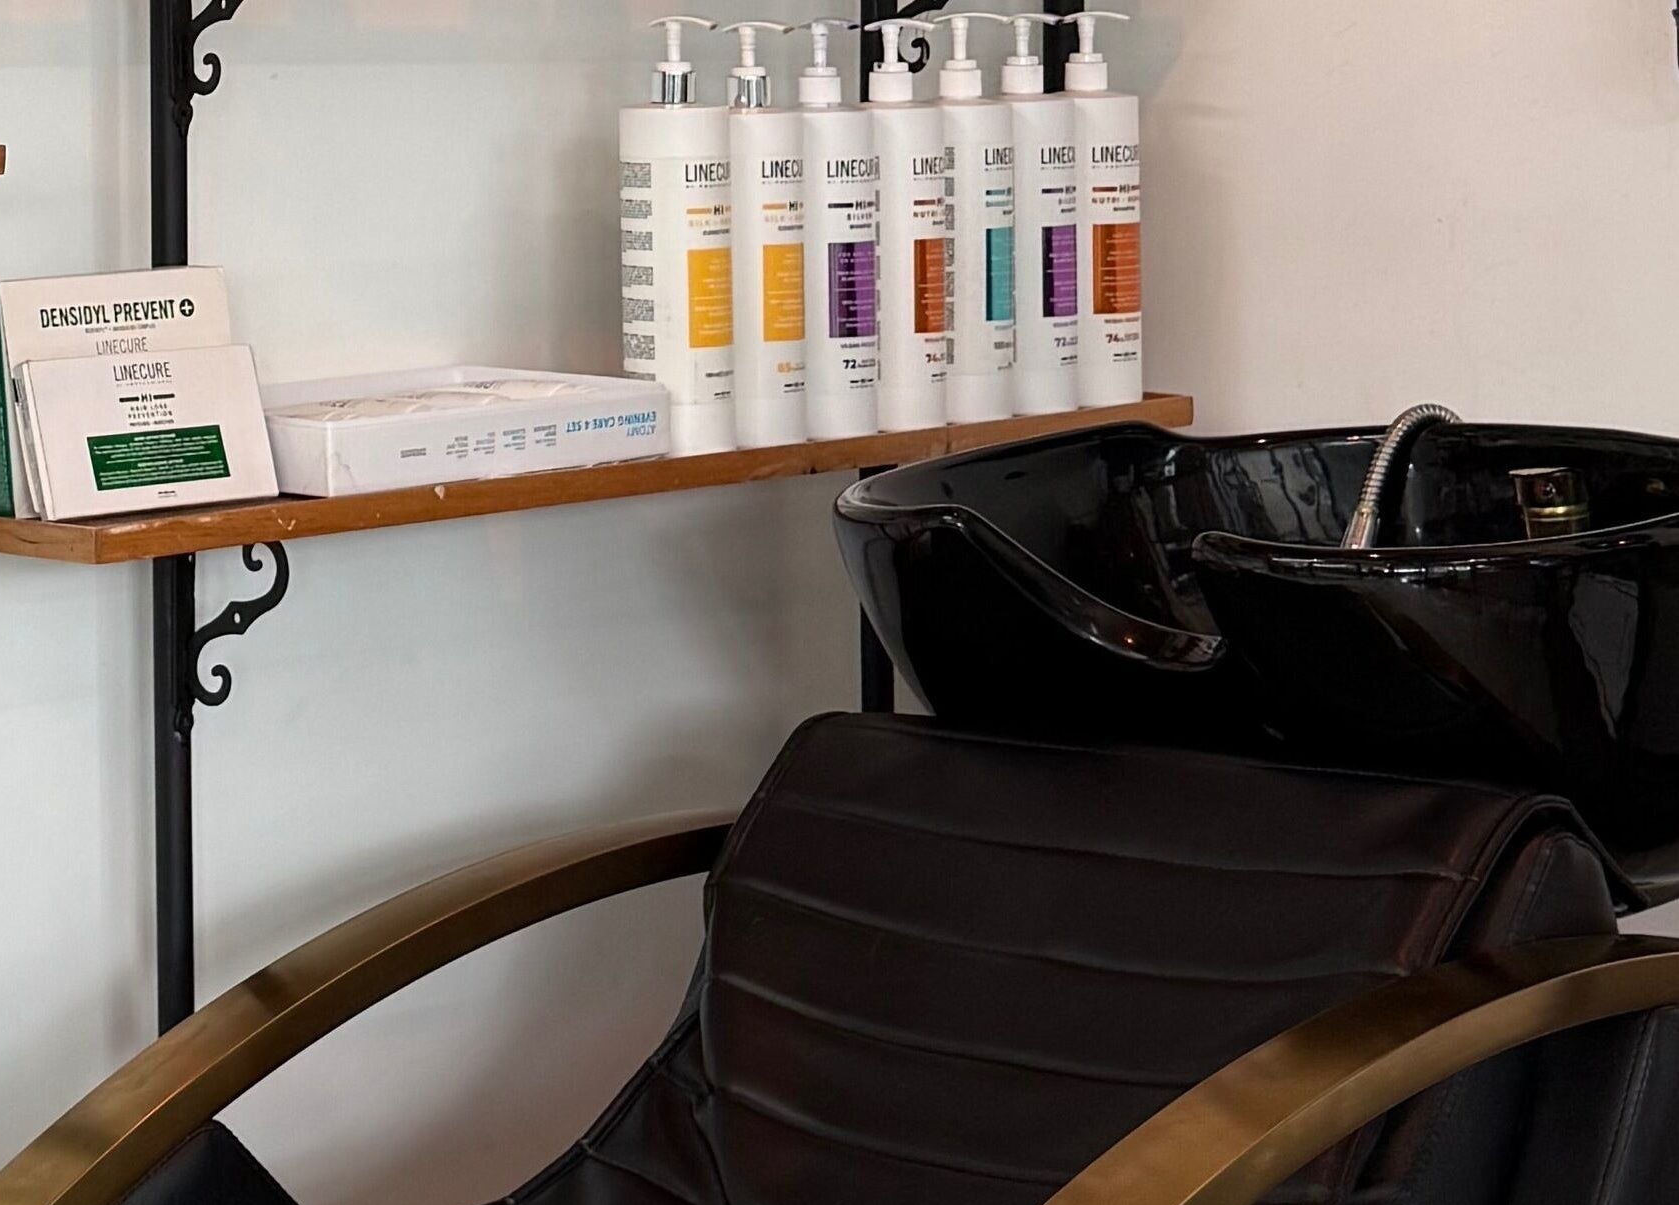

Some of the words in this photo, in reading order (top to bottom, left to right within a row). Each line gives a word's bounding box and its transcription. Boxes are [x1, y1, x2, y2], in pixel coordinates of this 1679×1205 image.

[39, 304, 110, 328] DENSIDYL
[113, 299, 175, 323] PREVENT
[96, 336, 148, 355] LINECURE
[113, 361, 172, 381] LINECURE
[566, 421, 582, 433] SET
[592, 416, 615, 430] CARE
[618, 411, 656, 426] EVENING
